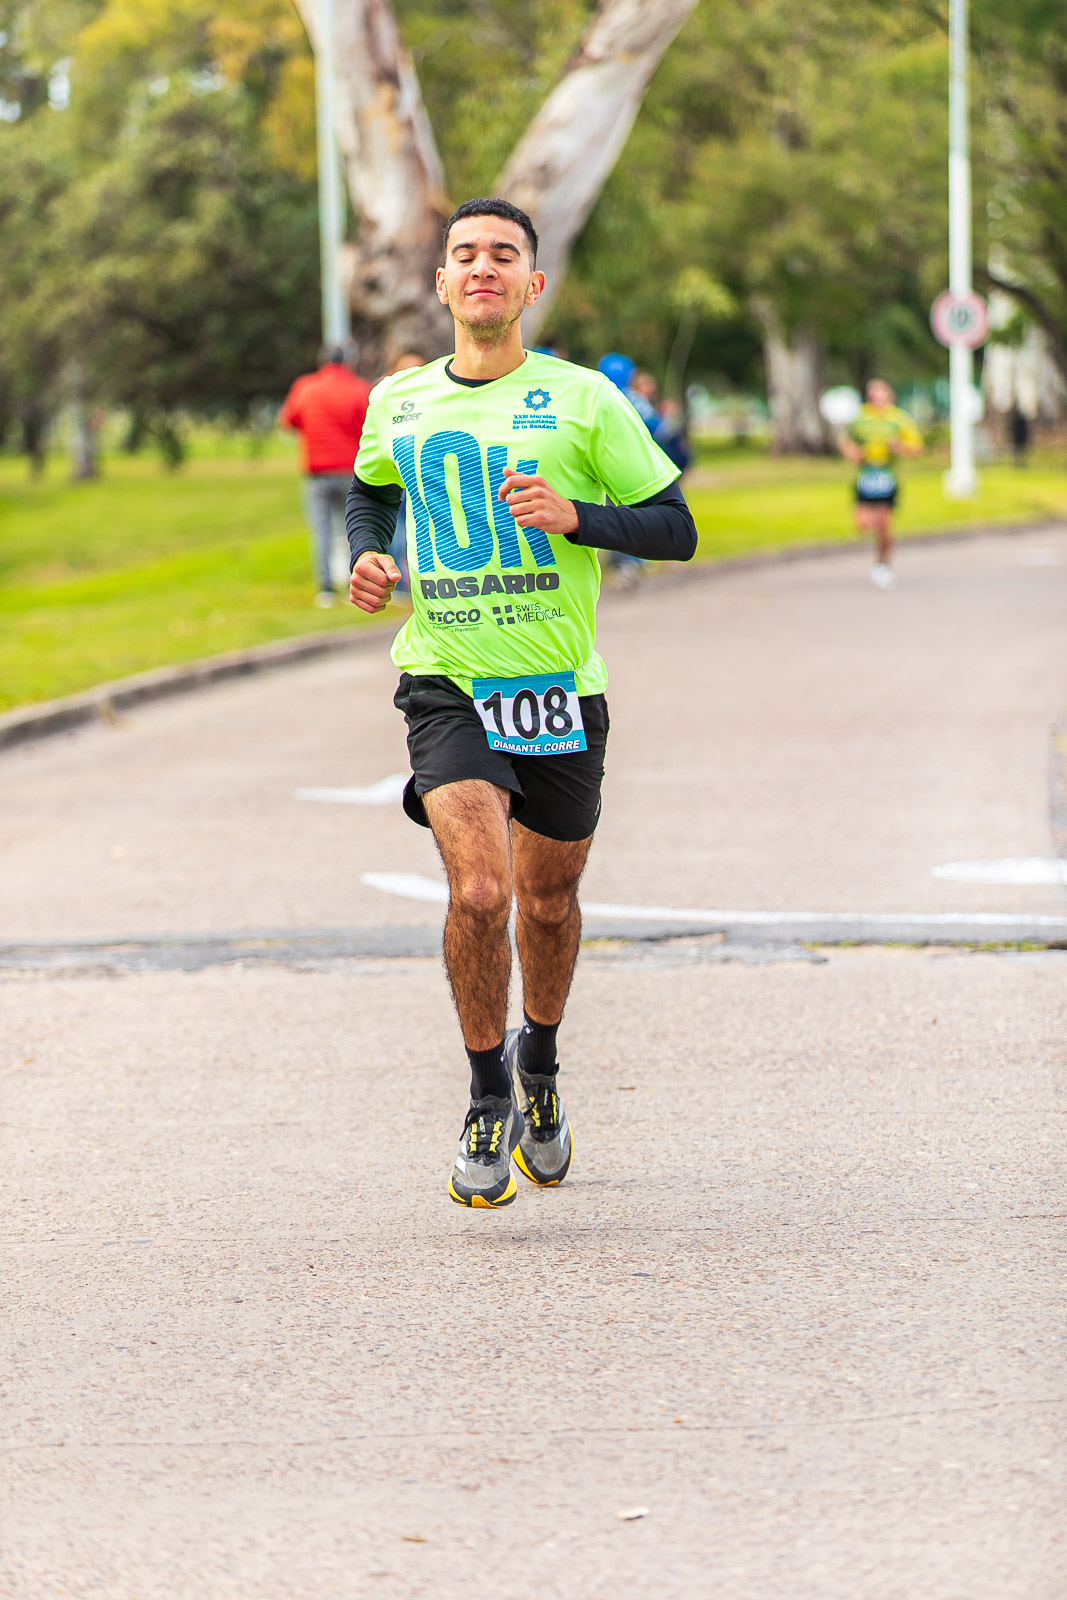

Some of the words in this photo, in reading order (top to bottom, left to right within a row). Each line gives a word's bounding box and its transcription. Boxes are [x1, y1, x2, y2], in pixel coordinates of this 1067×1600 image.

[420, 573, 560, 600] ROSARIO
[515, 602, 541, 613] SWISS
[516, 606, 566, 623] MEDICAL
[482, 685, 573, 741] 108
[493, 739, 542, 753] DIAMANTE
[543, 739, 581, 752] CORRE
